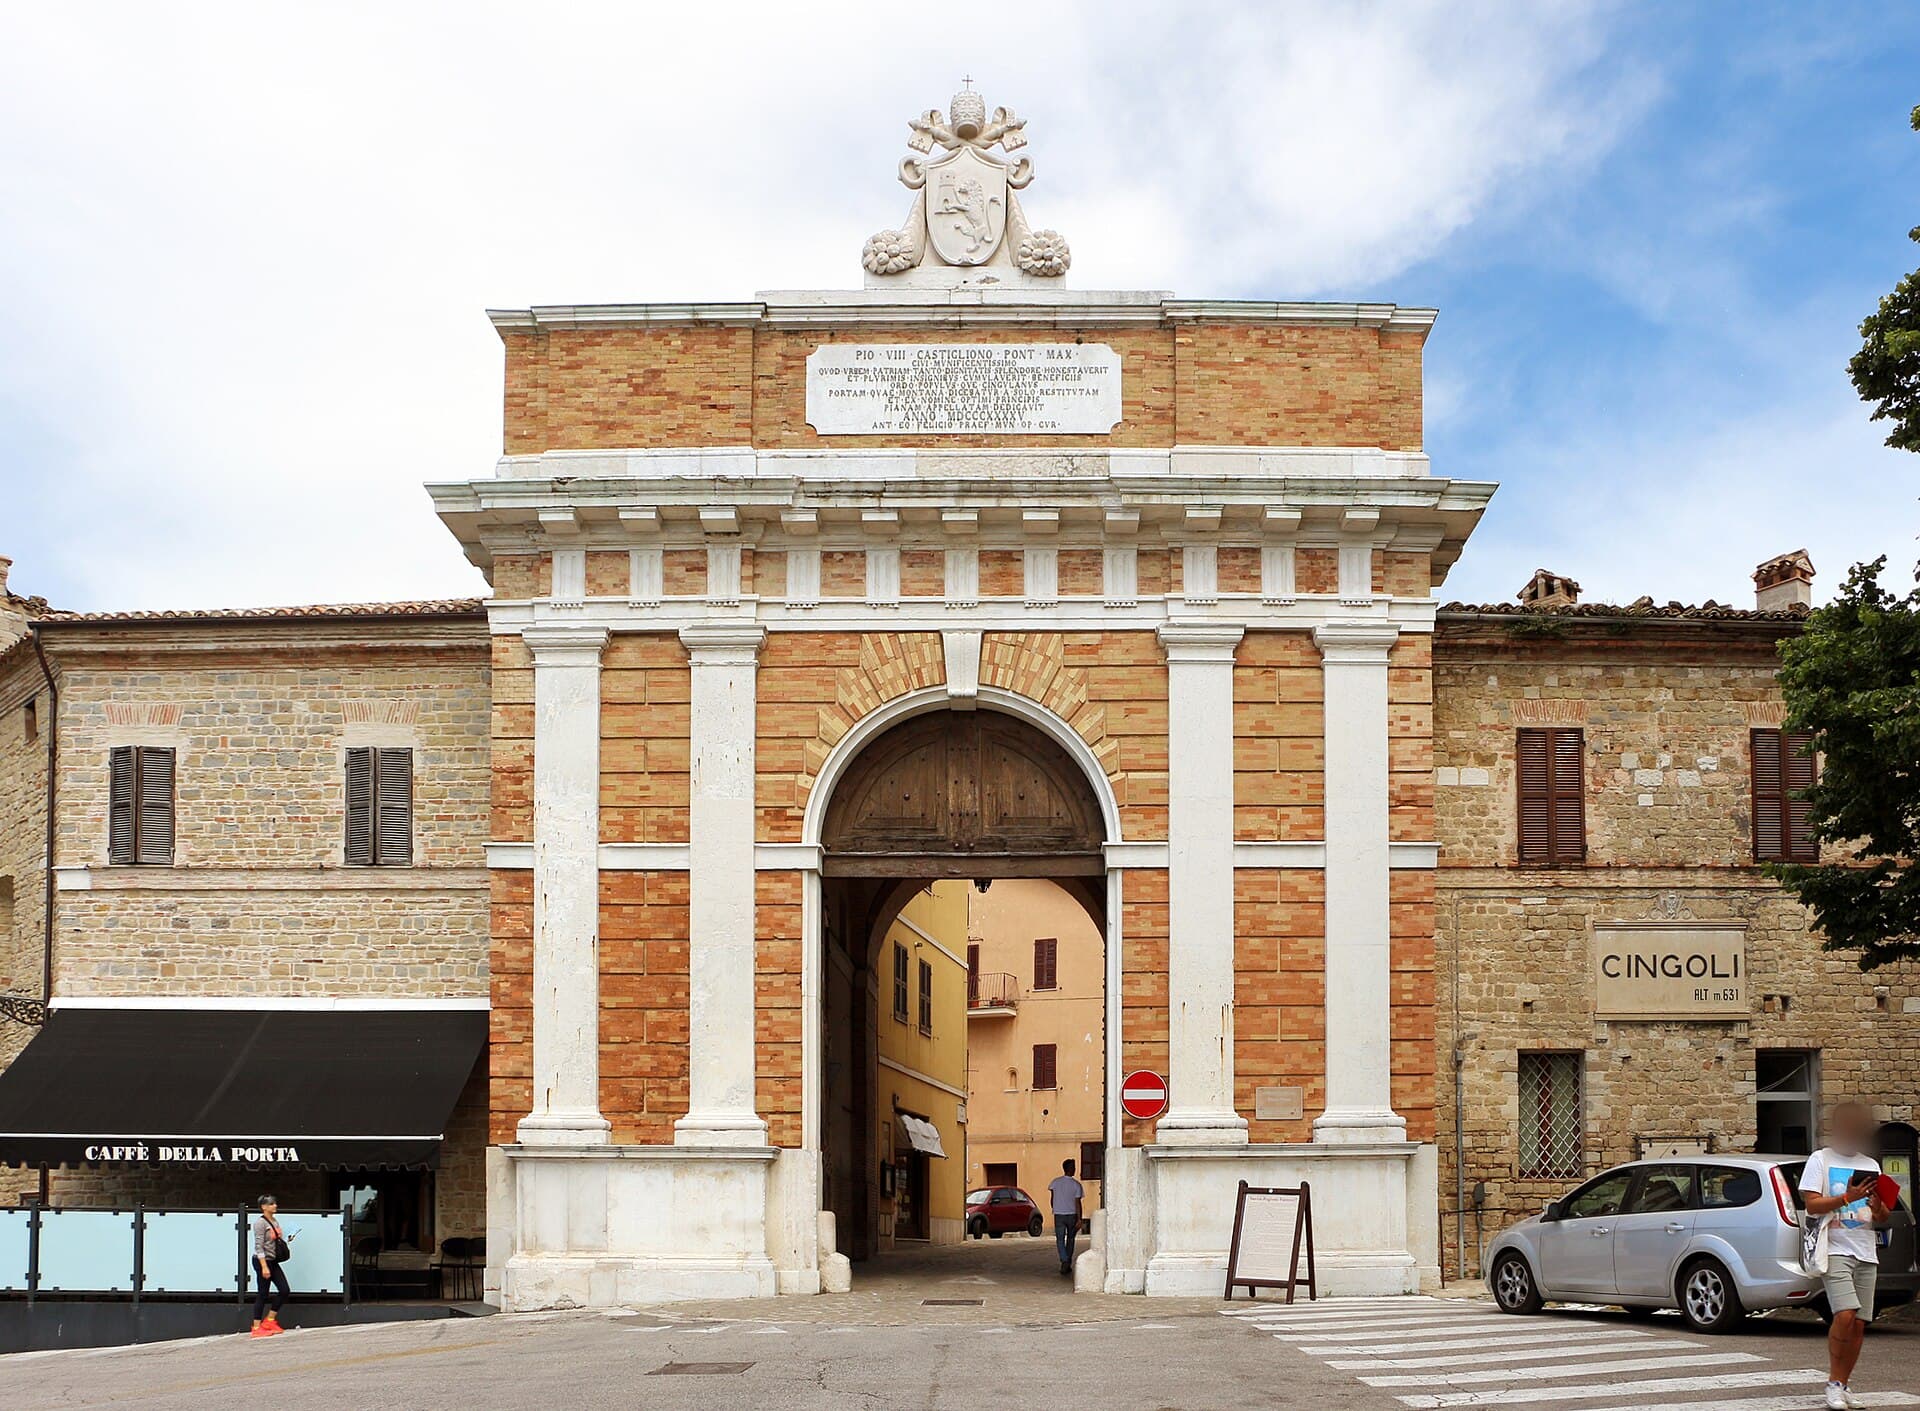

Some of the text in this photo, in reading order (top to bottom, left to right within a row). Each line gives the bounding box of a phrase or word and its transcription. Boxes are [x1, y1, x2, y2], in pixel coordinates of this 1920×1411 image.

[856, 349, 1072, 360] PIO VIII CASTIGLIONO PONT MAX
[1602, 954, 1738, 978] CINGOLI
[1694, 989, 1708, 1001] ALT
[85, 1141, 299, 1162] CAFFÈ DELLA PORTA
